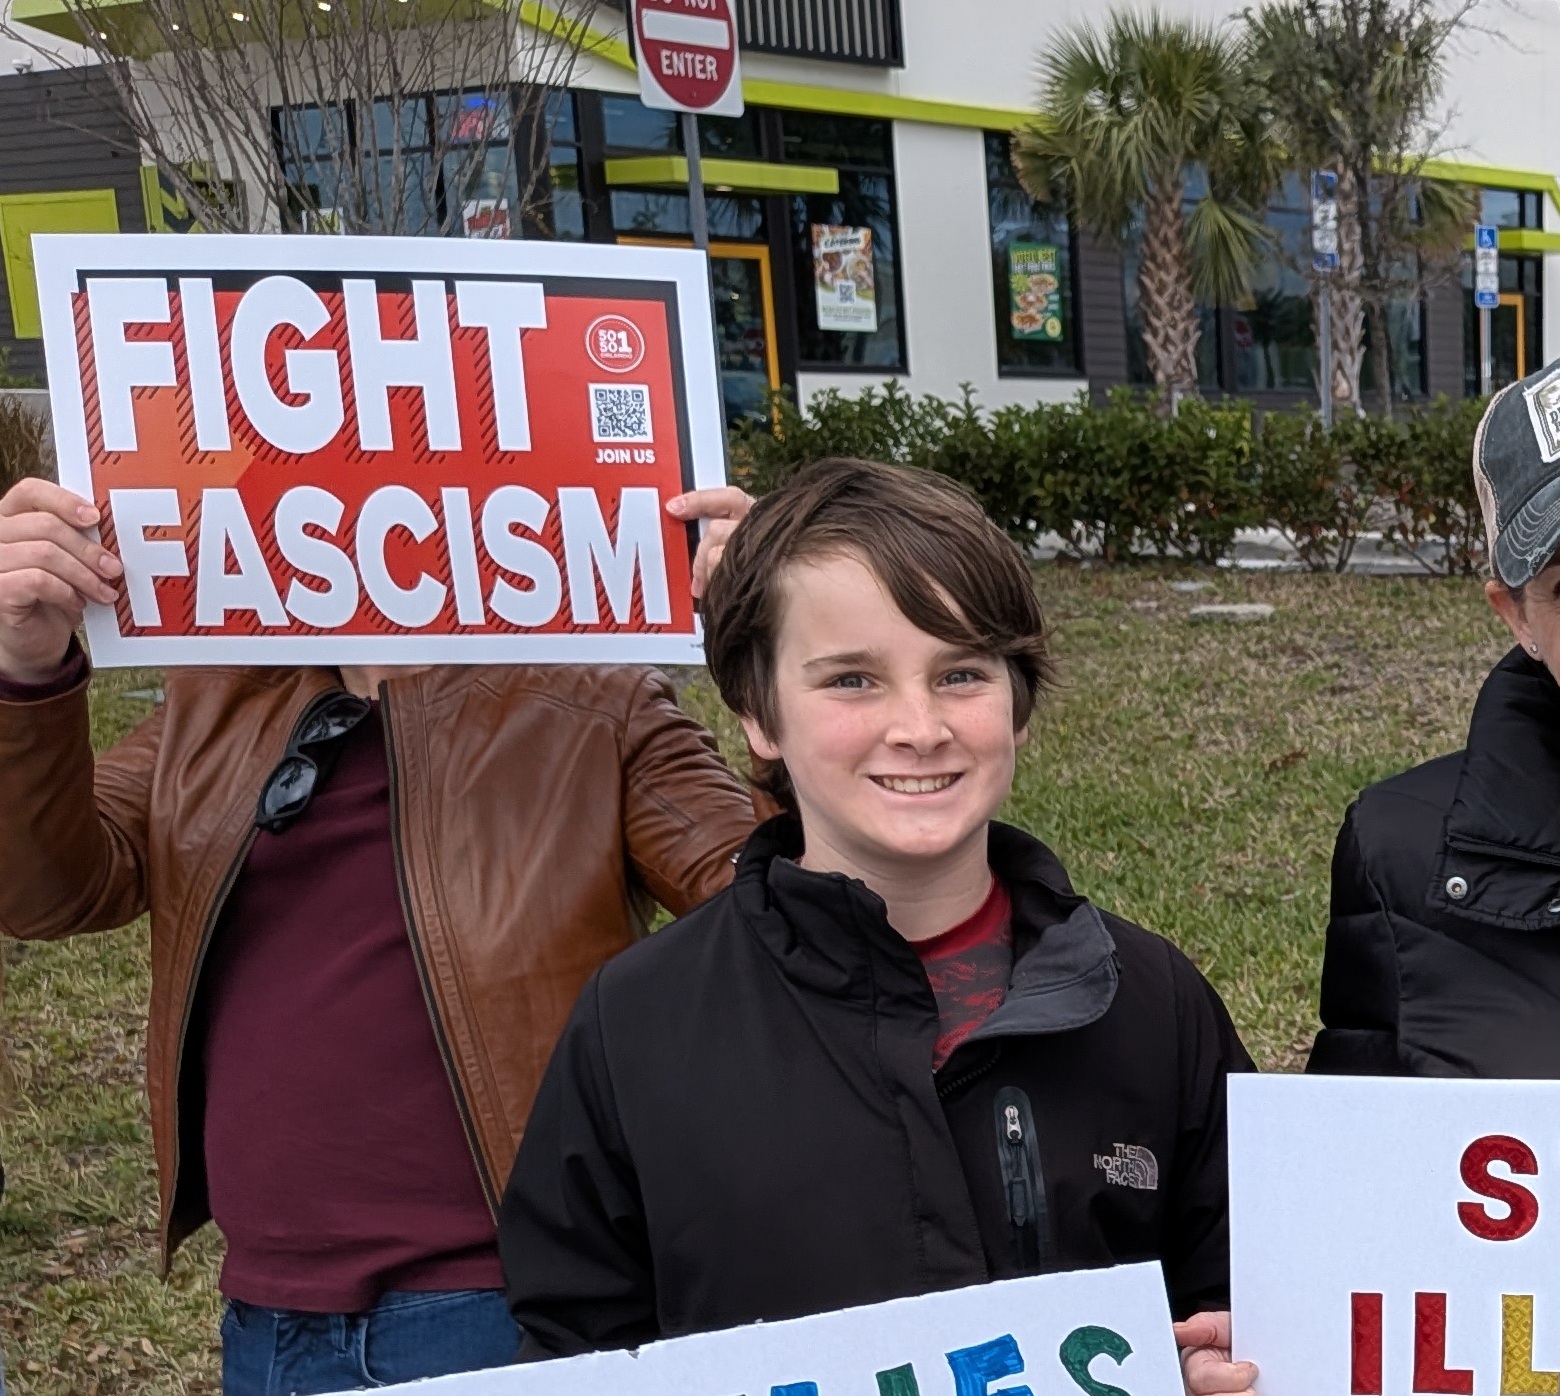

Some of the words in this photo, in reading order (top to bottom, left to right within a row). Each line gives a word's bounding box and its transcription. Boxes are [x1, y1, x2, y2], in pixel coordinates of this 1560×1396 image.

[660, 49, 718, 81] ENTER
[86, 275, 547, 455] FIGHT
[596, 449, 631, 464] JOIN
[634, 449, 655, 464] US
[109, 485, 672, 629] FASCISM
[1112, 1142, 1137, 1158] THE
[1093, 1153, 1135, 1173] NORTH
[1106, 1169, 1137, 1188] FACE
